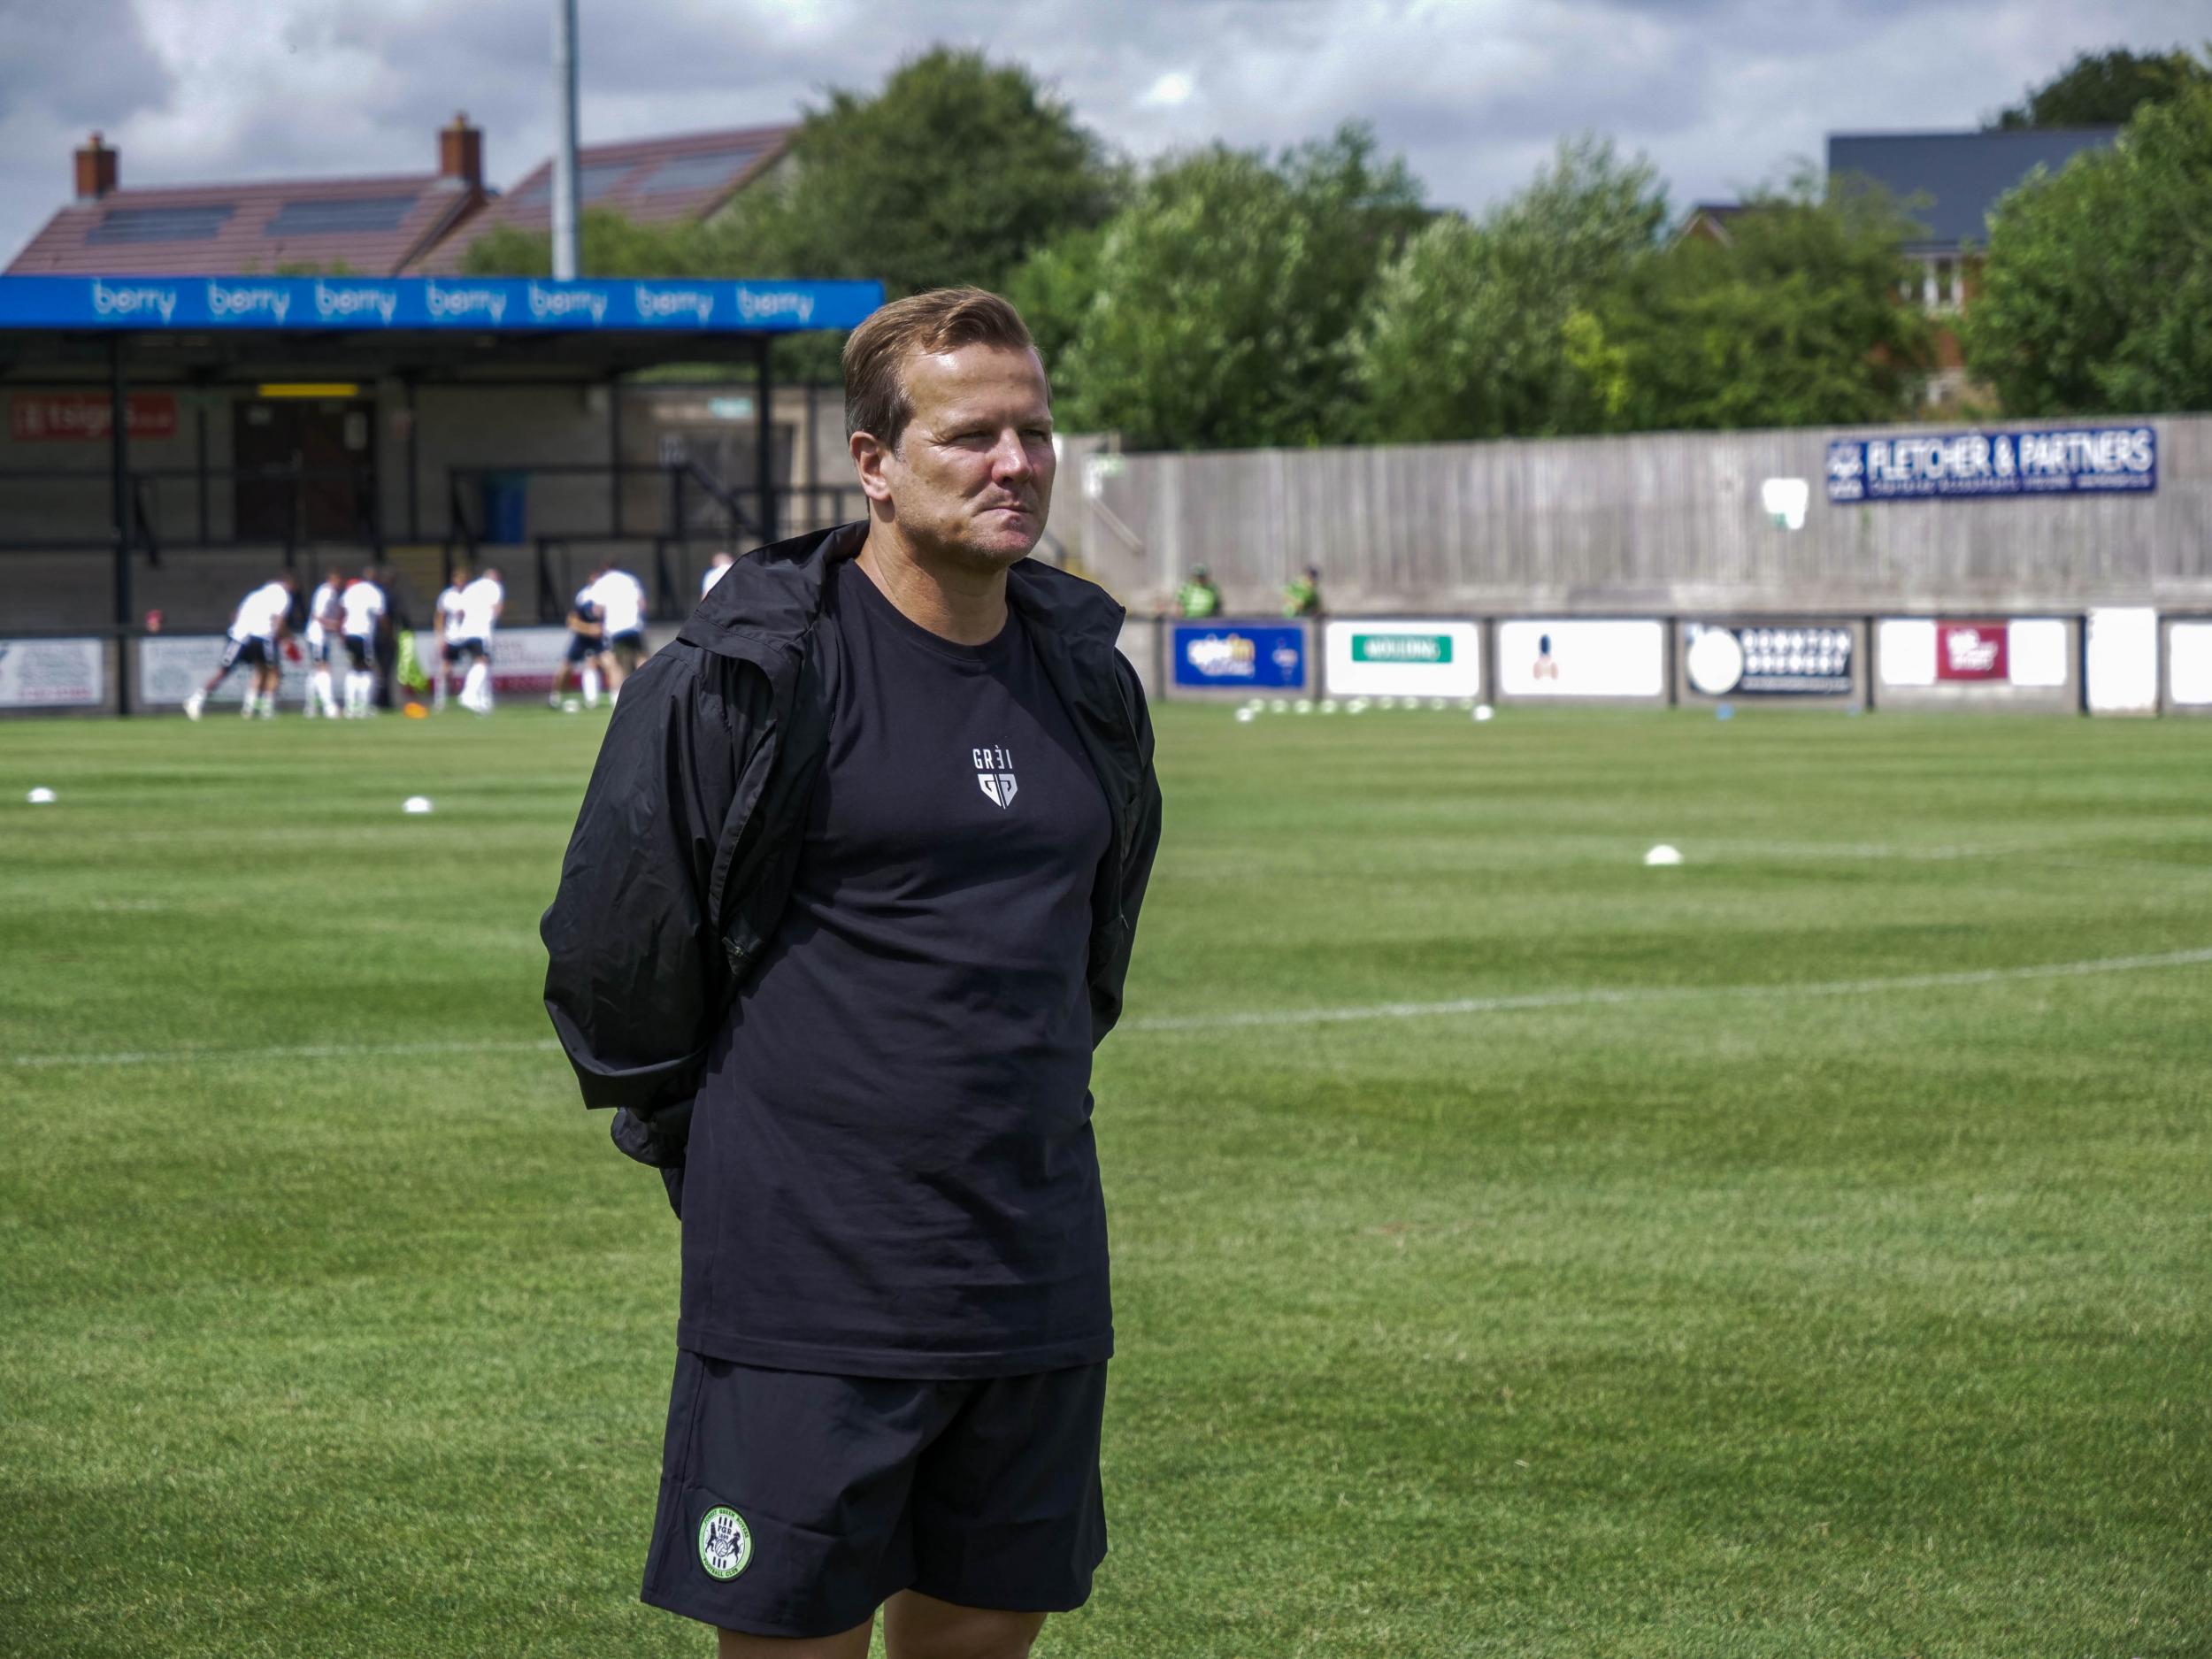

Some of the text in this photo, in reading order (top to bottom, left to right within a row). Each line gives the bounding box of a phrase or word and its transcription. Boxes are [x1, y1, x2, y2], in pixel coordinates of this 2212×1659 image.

[1867, 429, 2154, 480] FLETCHER & PARTNERS
[718, 1525, 732, 1535] FGR
[703, 1558, 739, 1577] FOOTBALL CLUB
